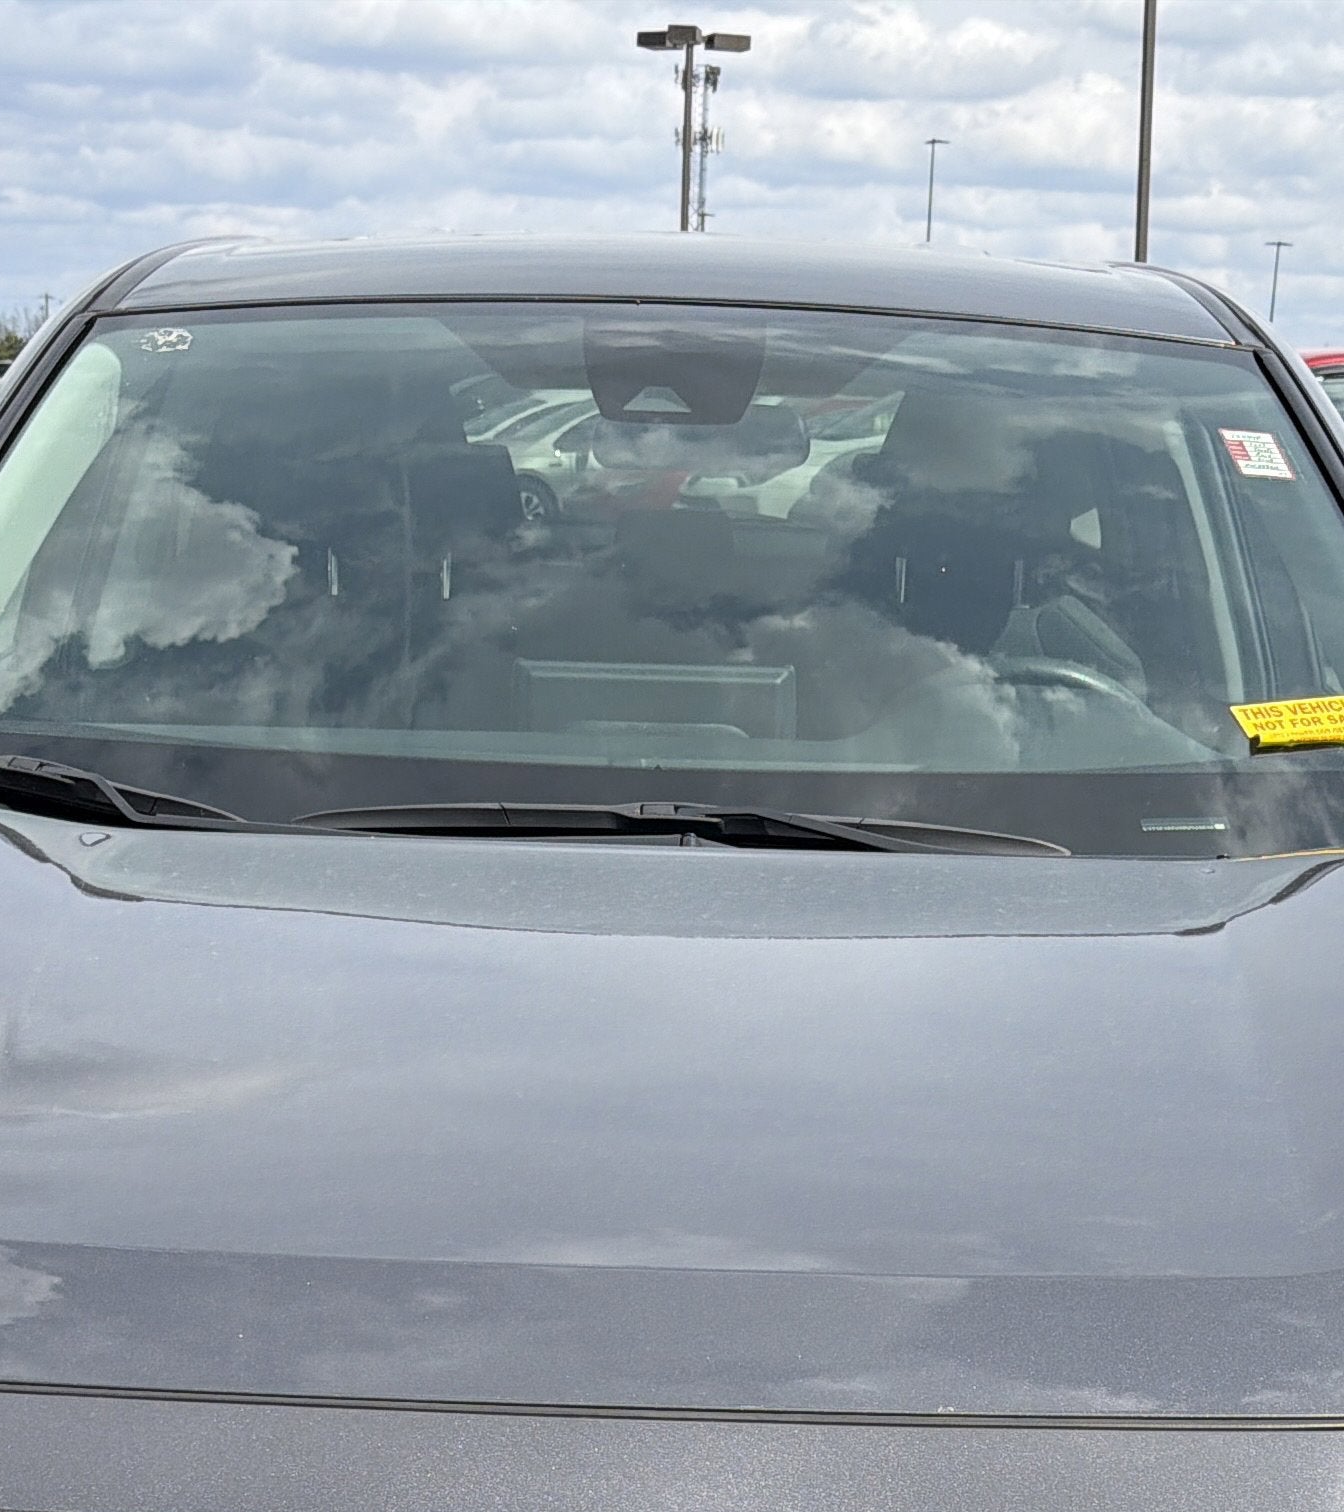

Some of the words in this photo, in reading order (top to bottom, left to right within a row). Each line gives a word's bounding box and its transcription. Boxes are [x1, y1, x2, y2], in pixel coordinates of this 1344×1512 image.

[1239, 705, 1283, 720] THIS
[1252, 719, 1285, 732] NOT
[1289, 716, 1323, 728] FOR
